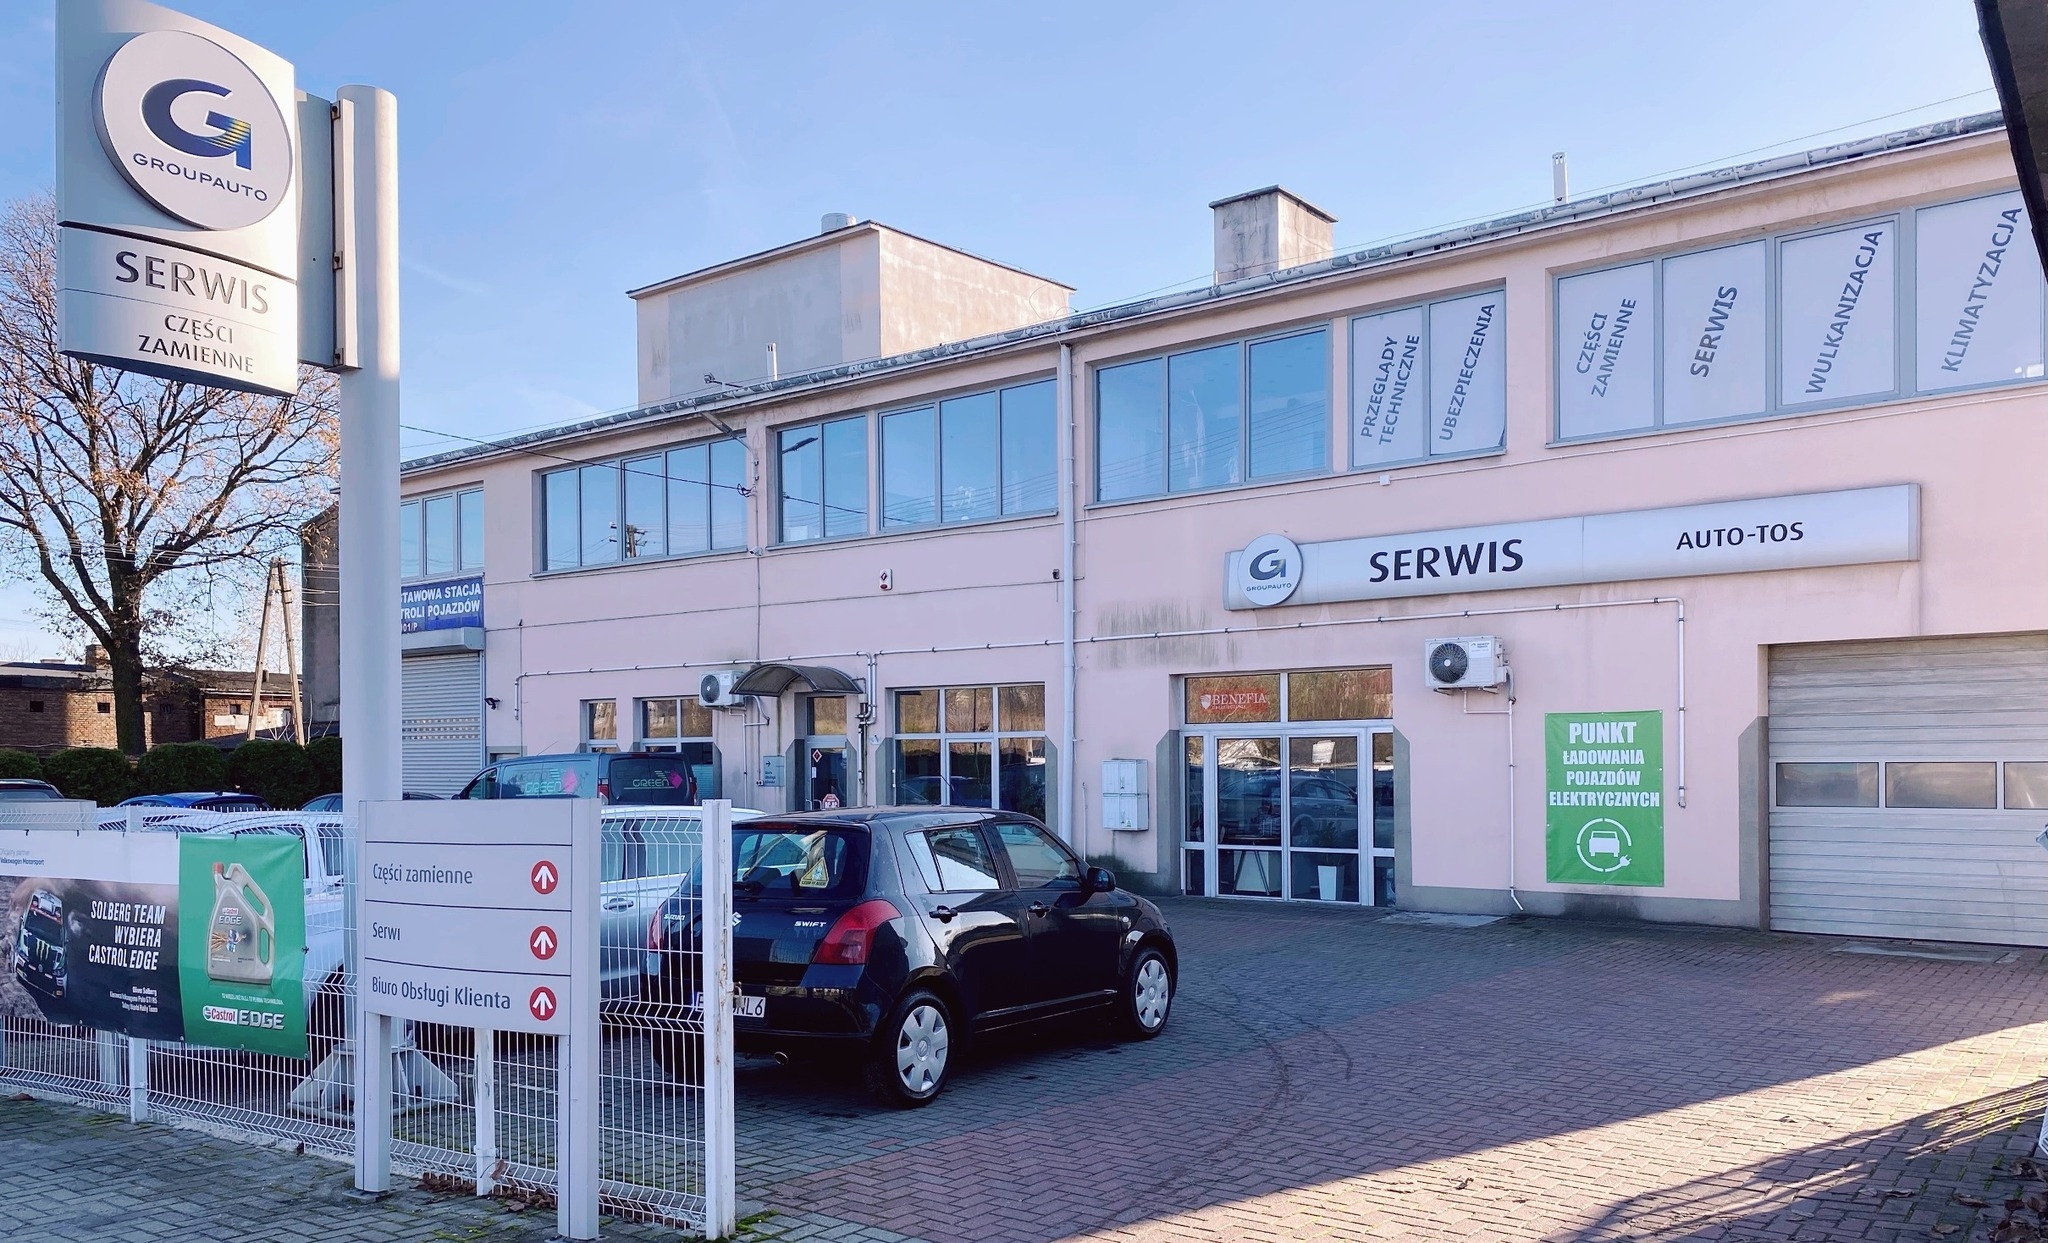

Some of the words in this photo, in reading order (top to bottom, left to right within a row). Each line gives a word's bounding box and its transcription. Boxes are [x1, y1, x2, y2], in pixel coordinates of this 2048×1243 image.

[133, 153, 268, 202] GROUPAUTO
[115, 251, 268, 314] SERWIS
[1941, 208, 2022, 373] KLIMATYZACJA
[1805, 231, 1883, 394] WULKANIZACJA
[164, 314, 233, 344] CZĘŚCI
[1691, 286, 1738, 378] SERWIS
[138, 334, 254, 374] ZAMIENNE
[1576, 312, 1608, 374] CZĘŚCI
[1591, 298, 1637, 398] ZAMIENNE
[1439, 304, 1496, 441] UBEZPIECZENIA
[1361, 336, 1398, 438] PRZEGLĄDY
[1379, 335, 1420, 445] TECHNICZNE
[1676, 522, 1804, 550] AUTO-TOS
[1369, 538, 1524, 583] SERWIS
[401, 588, 442, 603] TAWOWA
[444, 583, 481, 598] STACJA
[1246, 582, 1292, 592] GROUPAUTO
[428, 598, 480, 617] POJAZDÓW
[1212, 692, 1267, 705] BENEFIA
[1569, 722, 1637, 744] PUNKT
[1563, 750, 1645, 765] ŁADOWANIA
[633, 779, 669, 787] GREEN
[1566, 768, 1641, 786] POJAZDÓW
[1550, 792, 1660, 807] ELEKTRYCZNYCH
[373, 863, 402, 884] Części
[406, 865, 473, 884] zamienne
[91, 901, 131, 922] SOLBERG
[134, 904, 166, 924] TEAM
[219, 915, 242, 925] EDGE
[115, 925, 161, 947] WYBIERA
[372, 922, 400, 941] Serwi
[89, 944, 127, 967] CASTROL
[129, 950, 159, 970] EDGE
[372, 976, 398, 996] Biuro
[401, 982, 449, 1007] Obsługi
[455, 988, 511, 1010] Klienta
[212, 1008, 235, 1022] Castrol
[239, 1010, 285, 1029] EDGE
